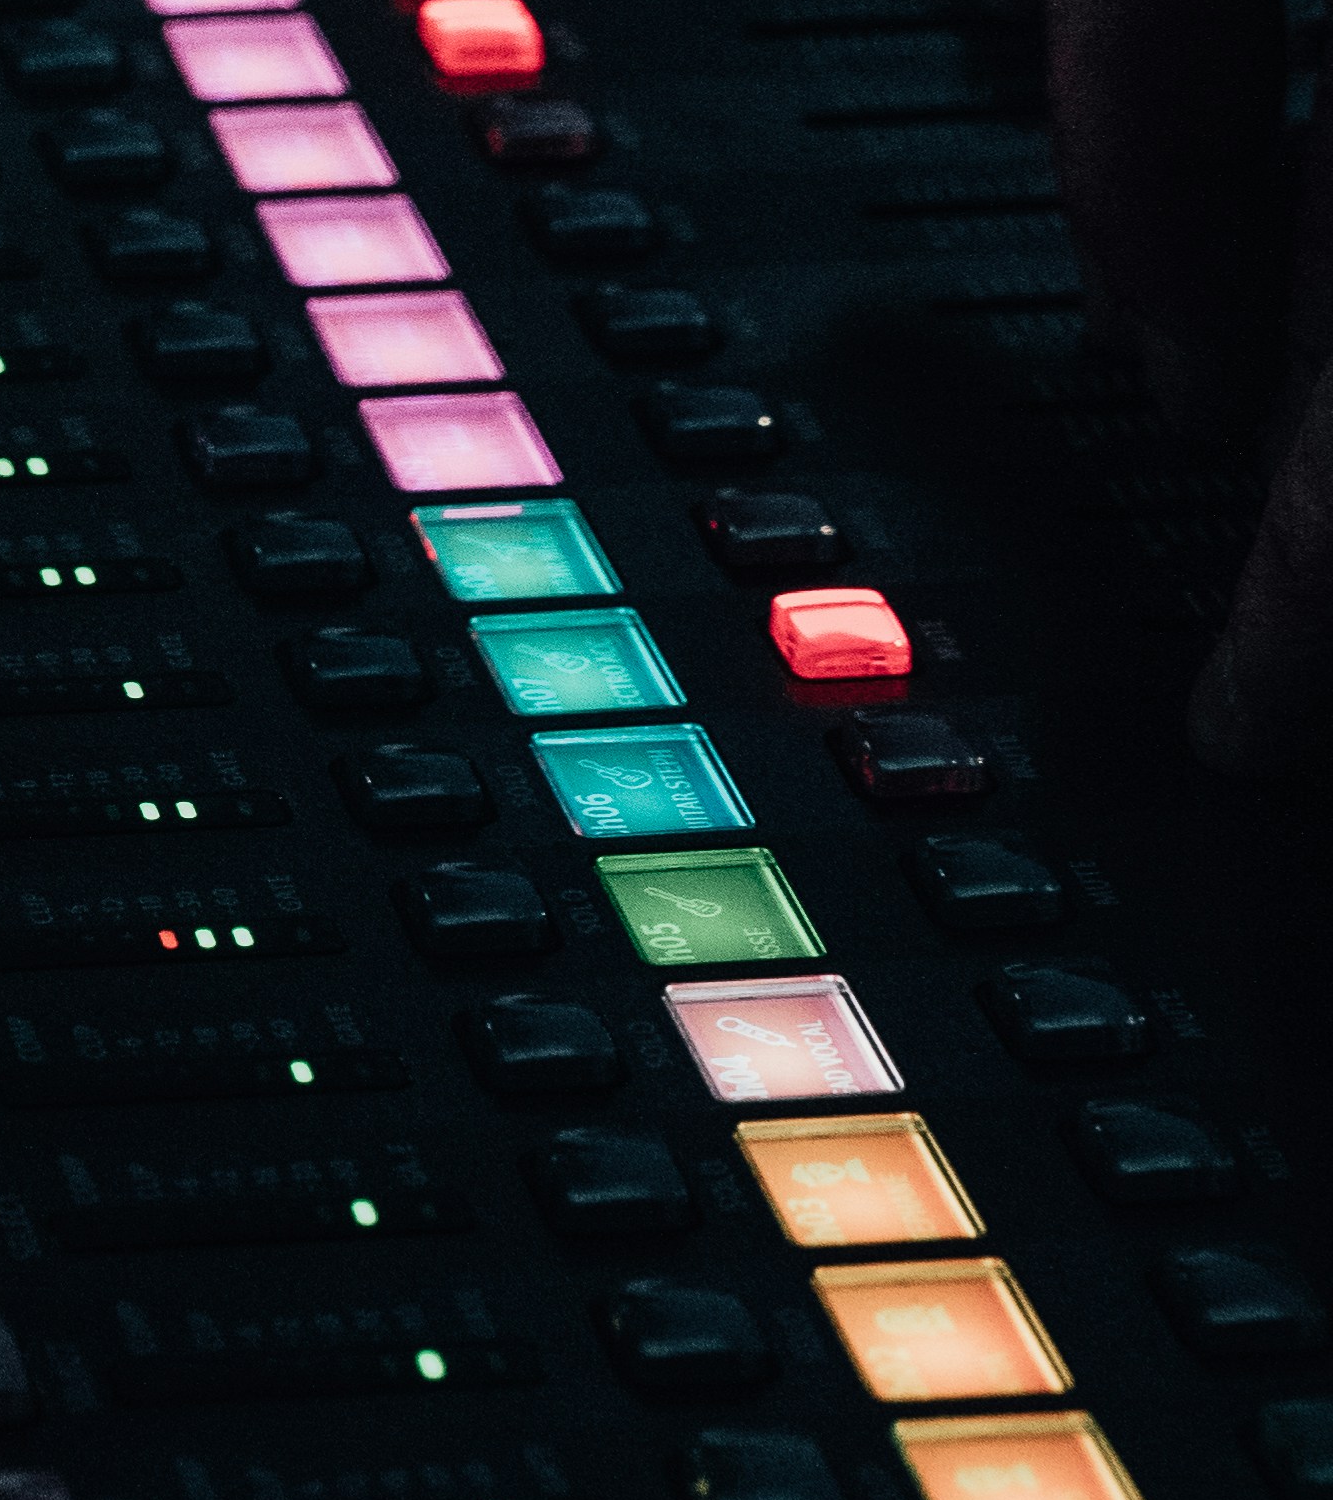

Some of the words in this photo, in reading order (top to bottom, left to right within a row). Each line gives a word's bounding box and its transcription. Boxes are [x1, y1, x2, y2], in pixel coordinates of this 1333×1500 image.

[158, 631, 194, 667] GATE
[210, 747, 248, 786] GATE
[645, 747, 692, 789] STEPH
[669, 790, 714, 828] UITAR
[265, 872, 306, 911] GATE
[1067, 858, 1122, 905] MUTE
[21, 892, 56, 924] CLIP
[558, 885, 605, 934] SOLO
[1151, 988, 1208, 1037] MUTE
[6, 1014, 47, 1062] COMP
[71, 1021, 110, 1059] CLIP
[796, 1018, 844, 1067] VOCAL
[709, 1054, 769, 1097] h04
[1240, 1123, 1293, 1180] MUTE
